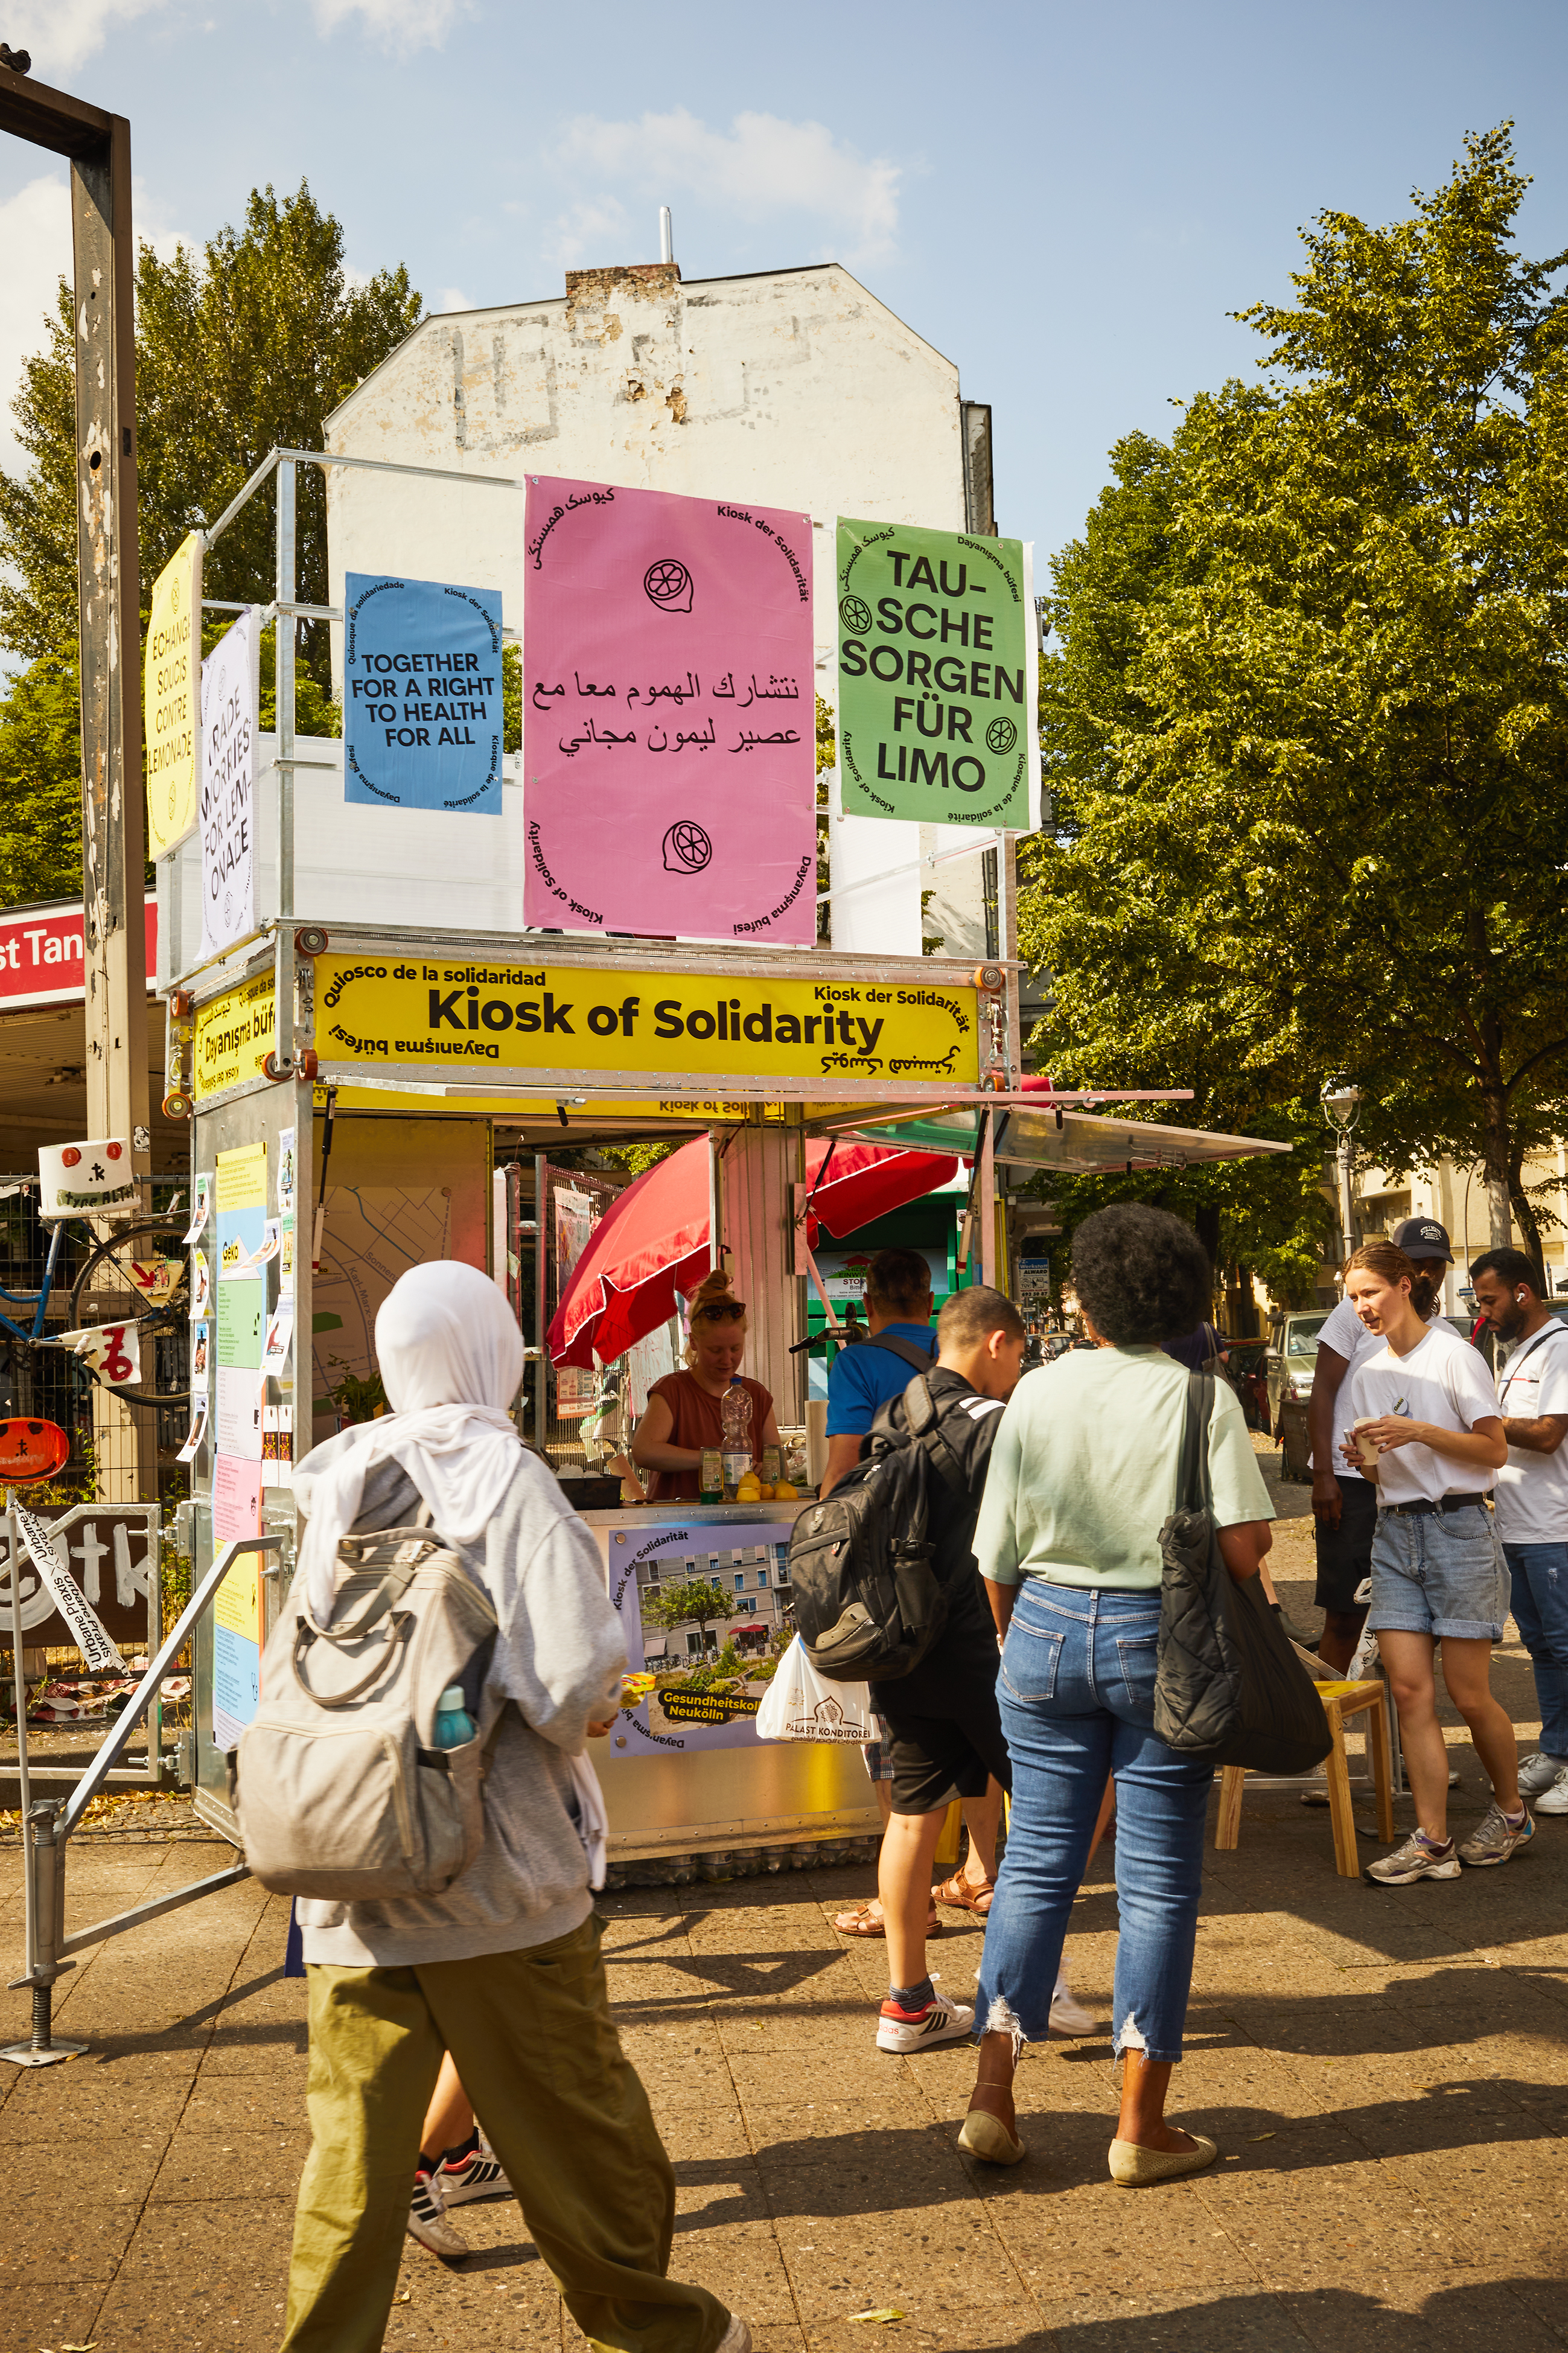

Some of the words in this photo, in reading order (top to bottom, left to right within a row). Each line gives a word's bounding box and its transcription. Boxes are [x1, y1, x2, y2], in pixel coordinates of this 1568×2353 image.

[717, 505, 753, 525] Kiosk
[754, 519, 776, 537] der
[774, 535, 809, 602] Solidarität
[957, 536, 1005, 571] Dayanışma
[1004, 570, 1021, 603] büfesi
[153, 613, 191, 660] ÉCHANGE
[348, 621, 357, 665] Quiosque
[355, 581, 405, 610] solidariedade
[444, 588, 468, 601] Kiosk
[469, 598, 482, 610] der
[481, 609, 499, 654] Solidarität
[876, 597, 994, 651] SCHE
[158, 654, 186, 695] SOUCIS
[362, 653, 480, 673] TOGETHER
[840, 639, 1024, 704] SORGEN
[352, 679, 398, 698] FOR
[405, 678, 422, 697] A
[427, 677, 495, 697] RIGHT
[532, 682, 566, 710] مع
[574, 671, 616, 697] معا
[626, 671, 701, 710] الهموم
[712, 672, 799, 709] نتشارك
[156, 694, 186, 734] CONTRE
[208, 684, 241, 767] TRADE
[365, 703, 397, 723] TO
[403, 702, 488, 722] HEALTH
[893, 691, 974, 744] FÜR
[148, 730, 192, 775] LEMONADE
[384, 728, 432, 747] FOR
[438, 727, 476, 746] ALL
[489, 735, 499, 772] Kiosque
[559, 718, 637, 757] مجاني
[647, 717, 716, 752] ليمون
[727, 729, 801, 753] عصير
[201, 717, 250, 822] WORRIES
[843, 730, 863, 784] Solidarity
[877, 742, 986, 793] LIMO
[1012, 753, 1026, 791] Kiosque
[359, 773, 401, 803] Dayanışma
[479, 786, 486, 794] la
[485, 771, 496, 784] de
[858, 781, 872, 794] of
[1005, 790, 1015, 803] de
[205, 811, 223, 867] FOR
[226, 770, 252, 829] LEM-
[444, 791, 481, 809] solidarité
[870, 792, 895, 814] Kiosk
[948, 806, 993, 823] solidarité
[993, 802, 1004, 813] la
[211, 817, 249, 901] ONADE
[527, 820, 556, 889] Solidarity
[552, 887, 568, 901] of
[771, 855, 812, 919] Dayanışma
[567, 898, 604, 925] Kiosk
[733, 916, 772, 936] büfesi
[260, 979, 267, 994] da
[323, 966, 387, 1009] Quiosco
[393, 965, 418, 980] de
[422, 966, 438, 981] la
[444, 967, 546, 986] solidaridad
[429, 985, 576, 1035] Kiosk
[587, 997, 640, 1036] of
[653, 998, 885, 1056] Solidarity
[814, 985, 861, 1002] Kiosk
[865, 988, 892, 1003] der
[896, 991, 970, 1034] Solidarität
[205, 1020, 250, 1064] Dayanışma
[328, 1024, 388, 1056] büfesi
[395, 1038, 500, 1058] Dayanışma
[223, 1240, 238, 1261] Geko
[1394, 1399, 1404, 1411] Geko
[20, 1515, 48, 1560] Urbane
[613, 1578, 628, 1611] Kiosk
[624, 1559, 637, 1577] der
[636, 1531, 689, 1560] Solidarität
[54, 1576, 80, 1616] Praxis
[75, 1616, 101, 1664] Urbane
[88, 1620, 112, 1659] Praxis
[669, 1705, 724, 1720] Neukölln
[785, 1723, 816, 1734] PALAST
[818, 1728, 870, 1738] KONDITOREI
